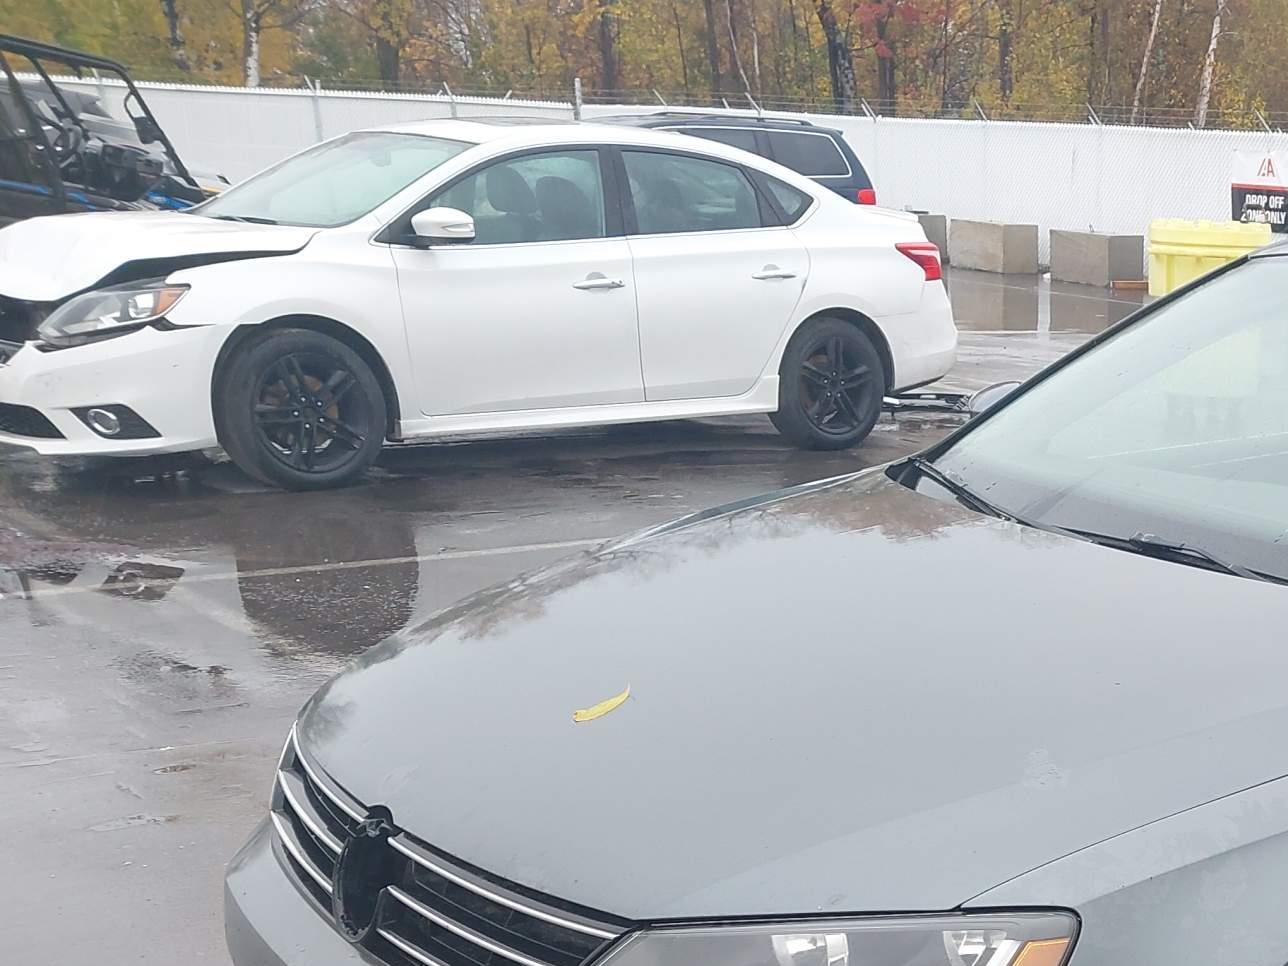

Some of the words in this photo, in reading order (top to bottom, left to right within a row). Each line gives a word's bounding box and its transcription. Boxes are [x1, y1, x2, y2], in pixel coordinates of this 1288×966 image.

[1245, 194, 1268, 208] DROP
[1269, 195, 1285, 209] OFF
[1264, 210, 1286, 224] ONLY
